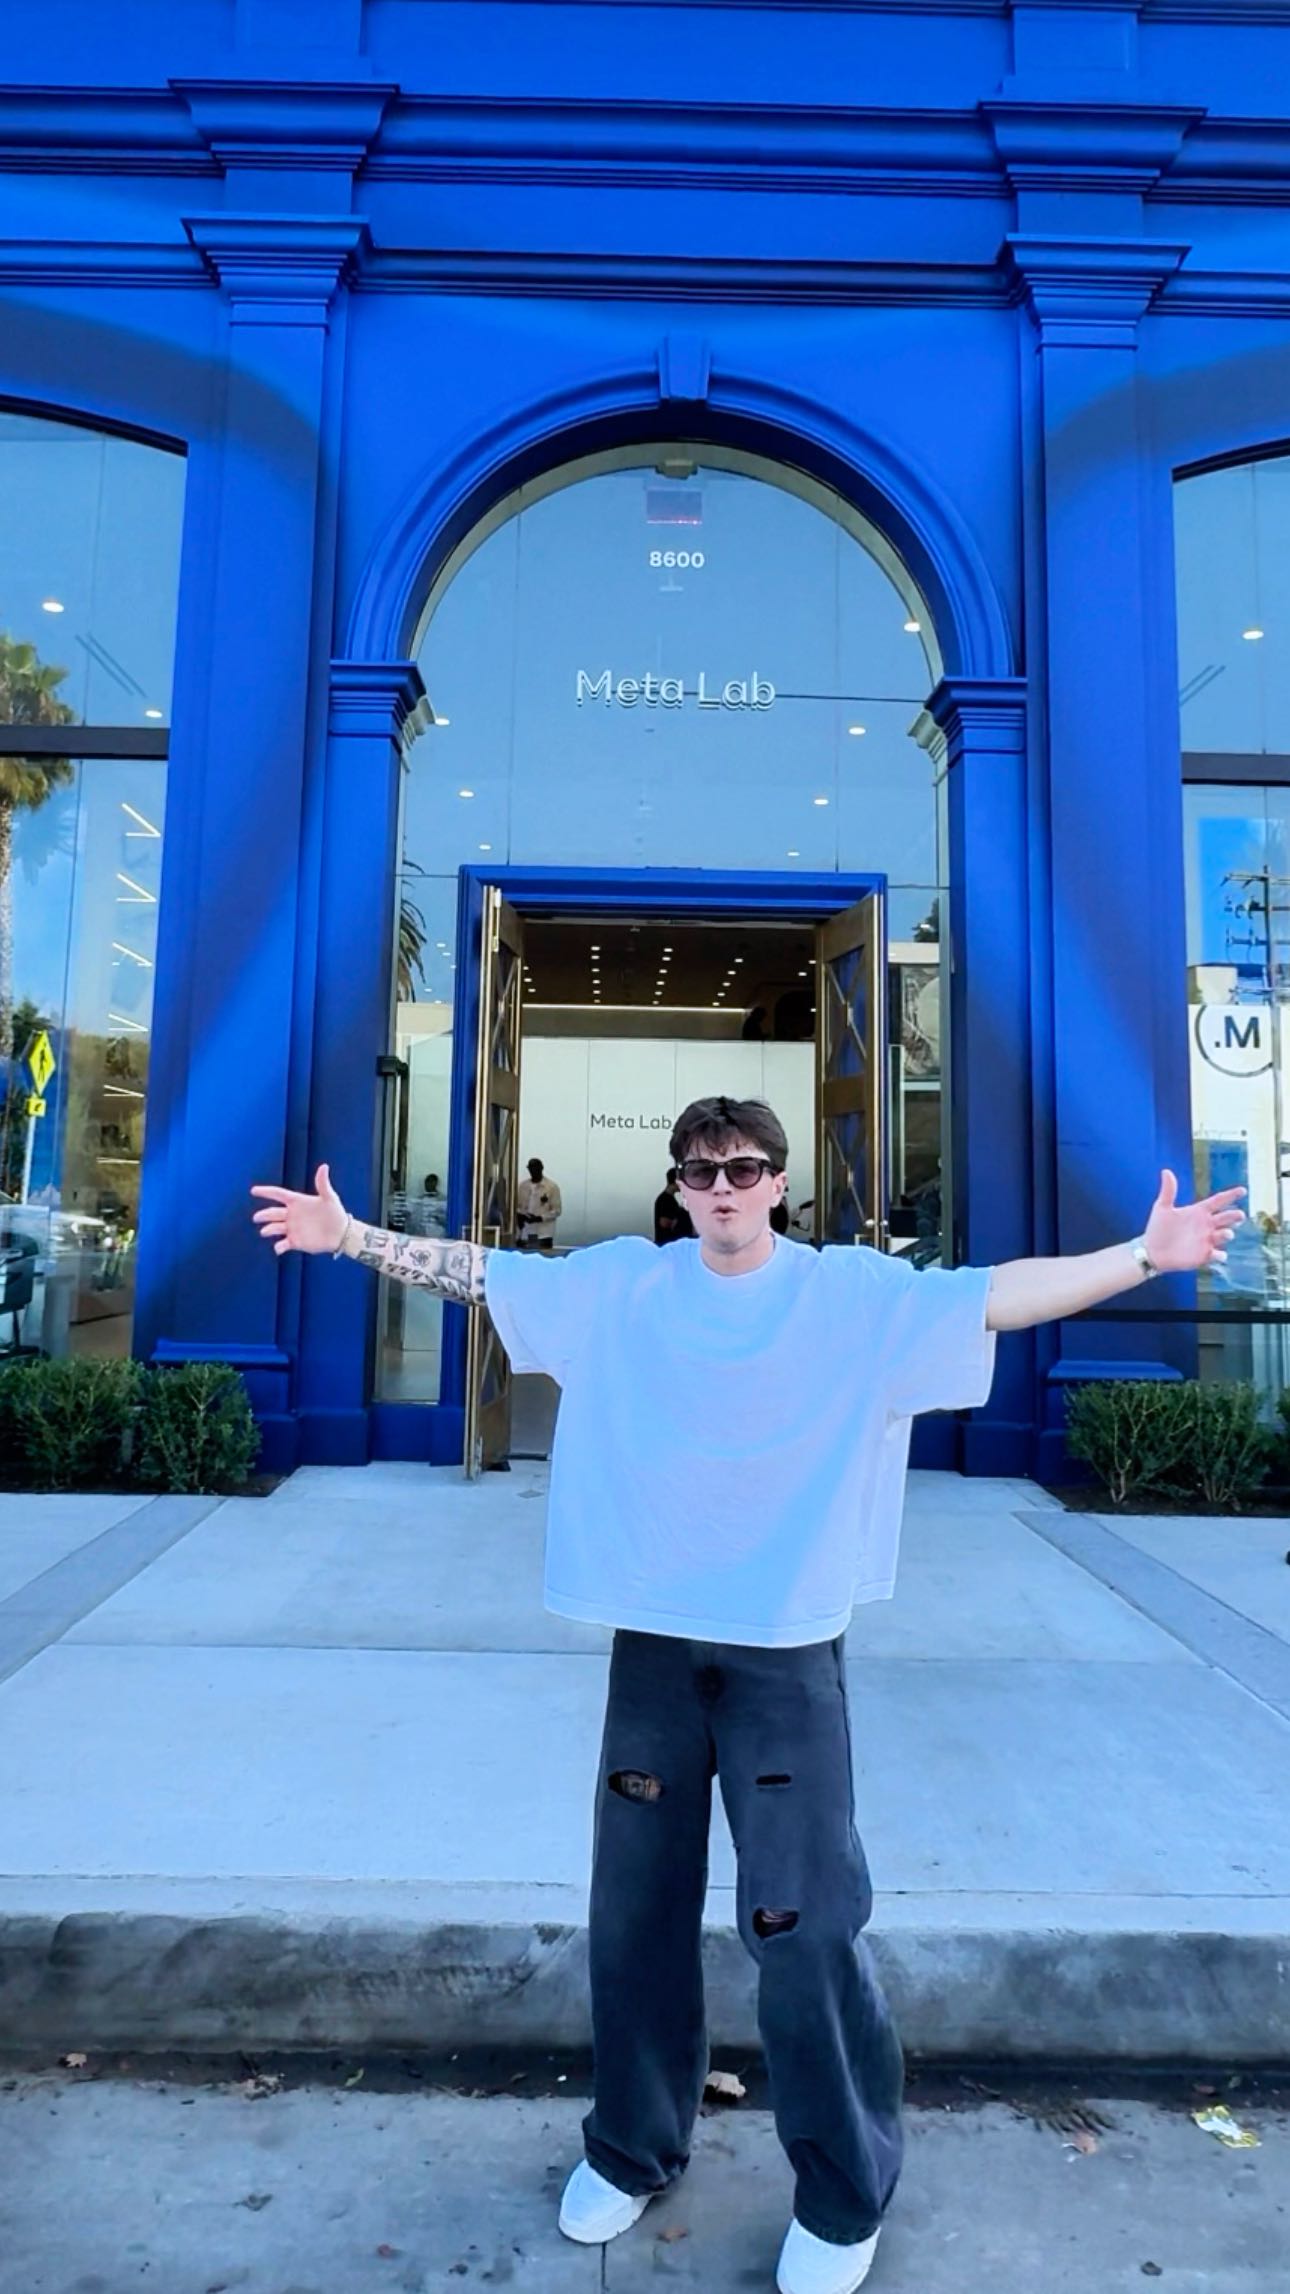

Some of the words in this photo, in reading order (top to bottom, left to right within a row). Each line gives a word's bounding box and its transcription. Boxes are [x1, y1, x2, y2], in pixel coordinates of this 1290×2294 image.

[649, 551, 705, 568] 8600
[576, 669, 684, 706] Meta
[698, 671, 775, 709] Lab
[591, 1113, 635, 1128] Meta
[639, 1114, 672, 1129] Lab
